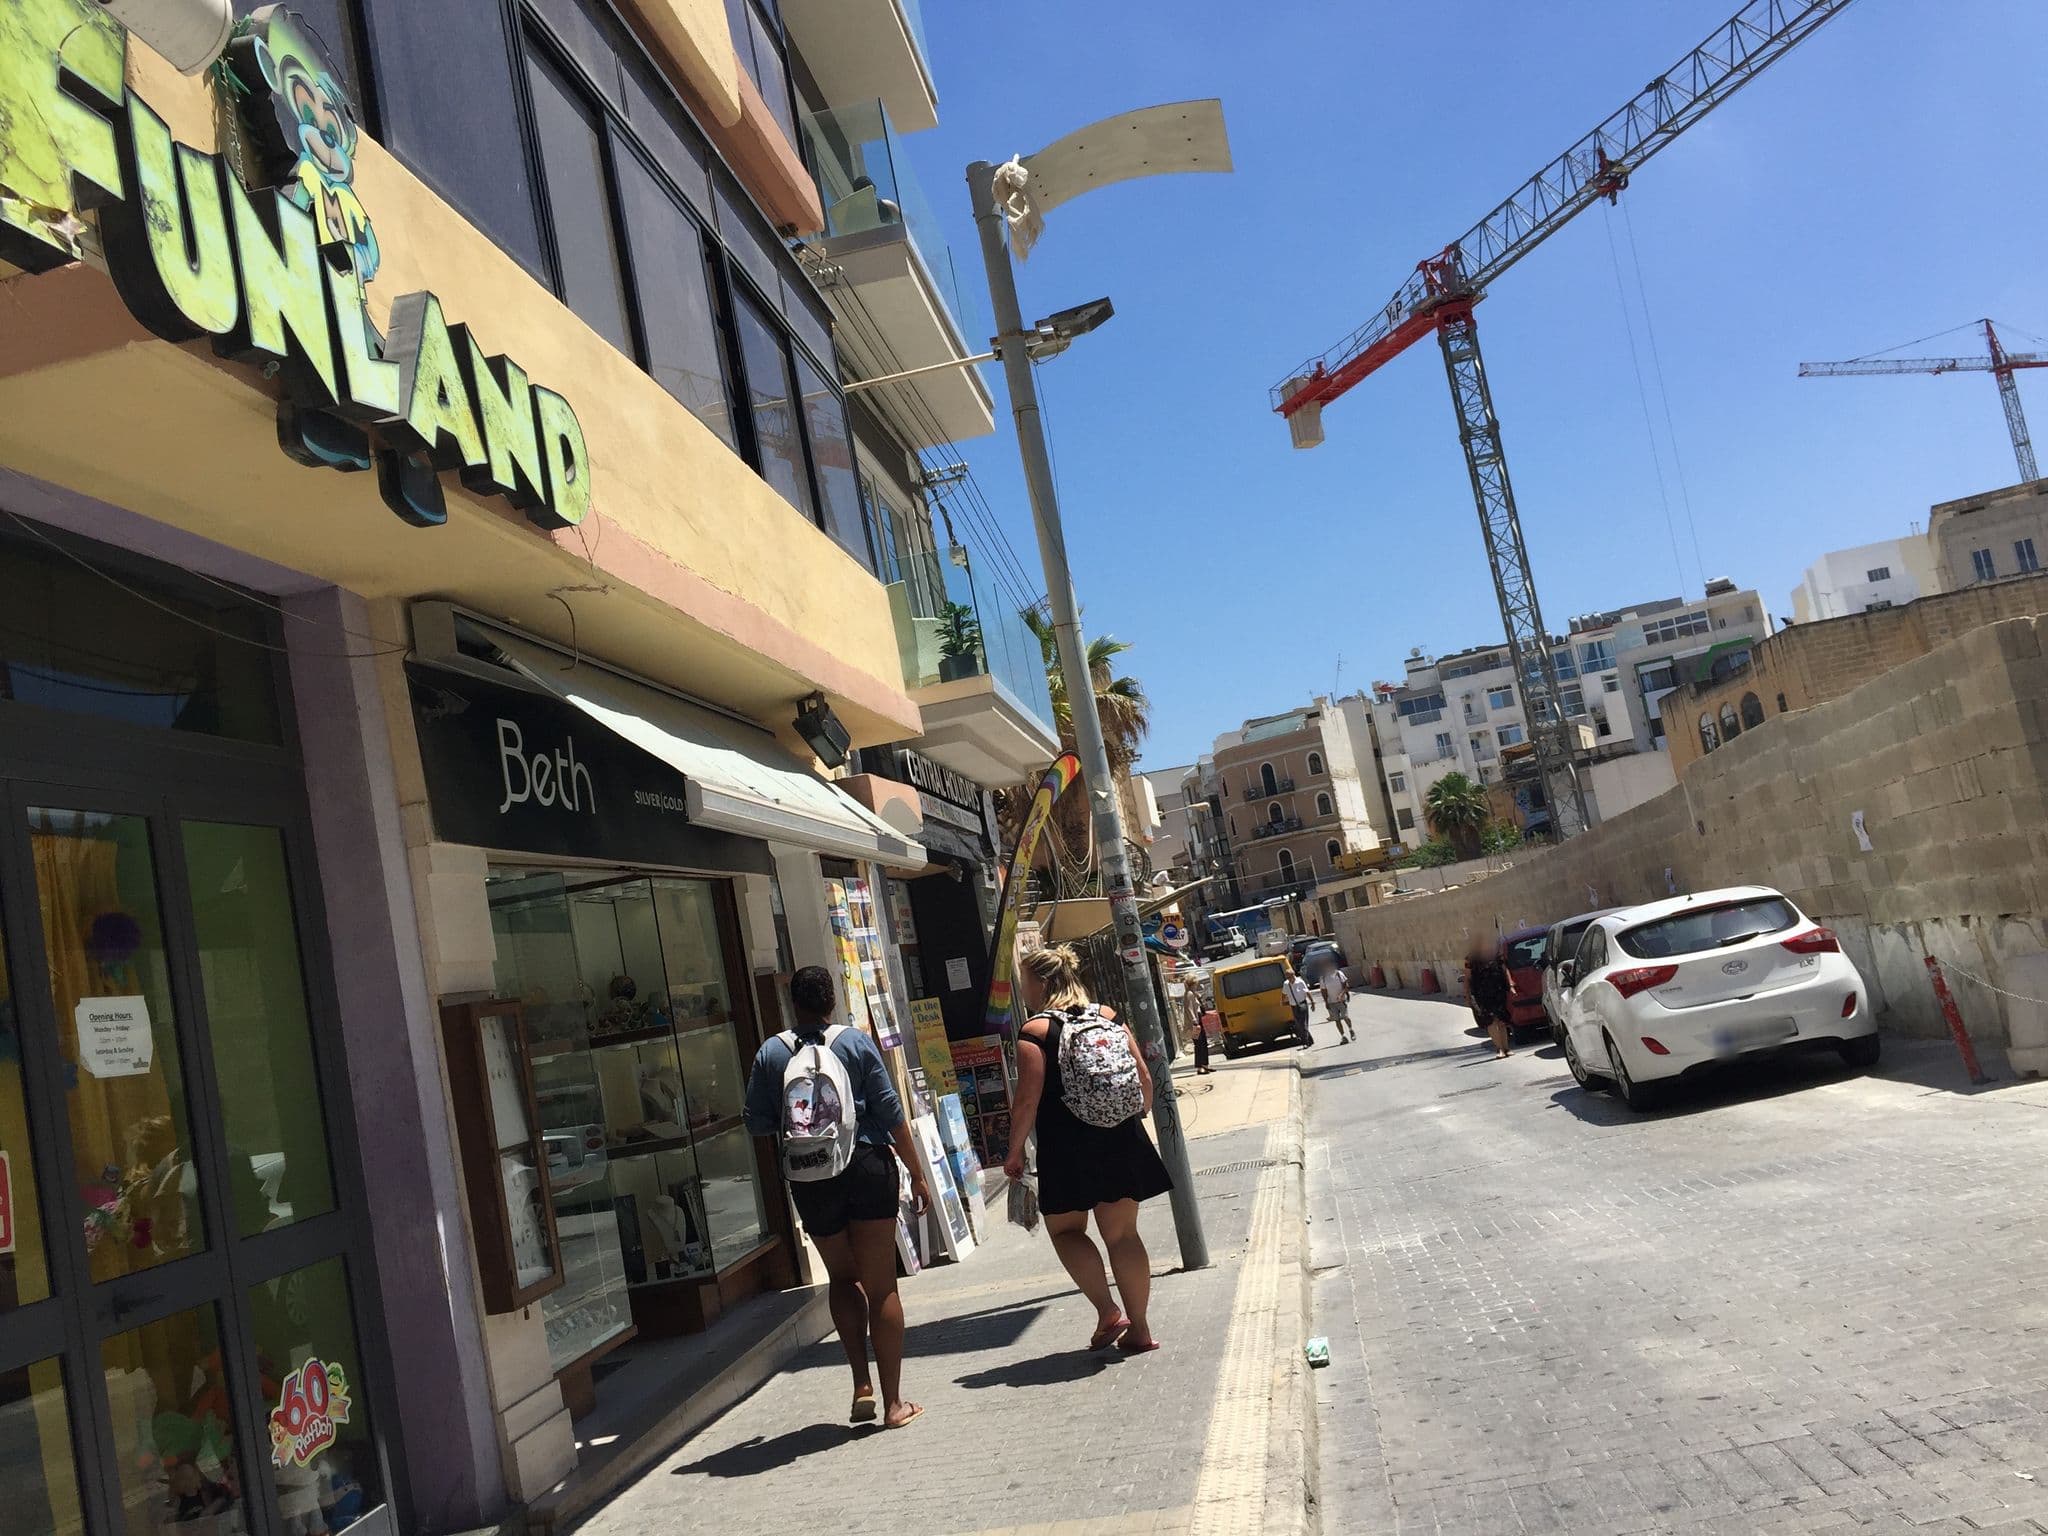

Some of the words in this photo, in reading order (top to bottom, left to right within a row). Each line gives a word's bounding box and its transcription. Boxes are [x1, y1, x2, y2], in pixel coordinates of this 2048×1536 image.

[0, 0, 592, 527] FUNLAND
[497, 718, 595, 814] Beth
[907, 750, 947, 797] CENTRAL
[942, 767, 981, 812] HOLIDAYS
[89, 1013, 113, 1022] Opening
[285, 1360, 329, 1436] 60
[295, 1416, 332, 1457] Play-Doh
